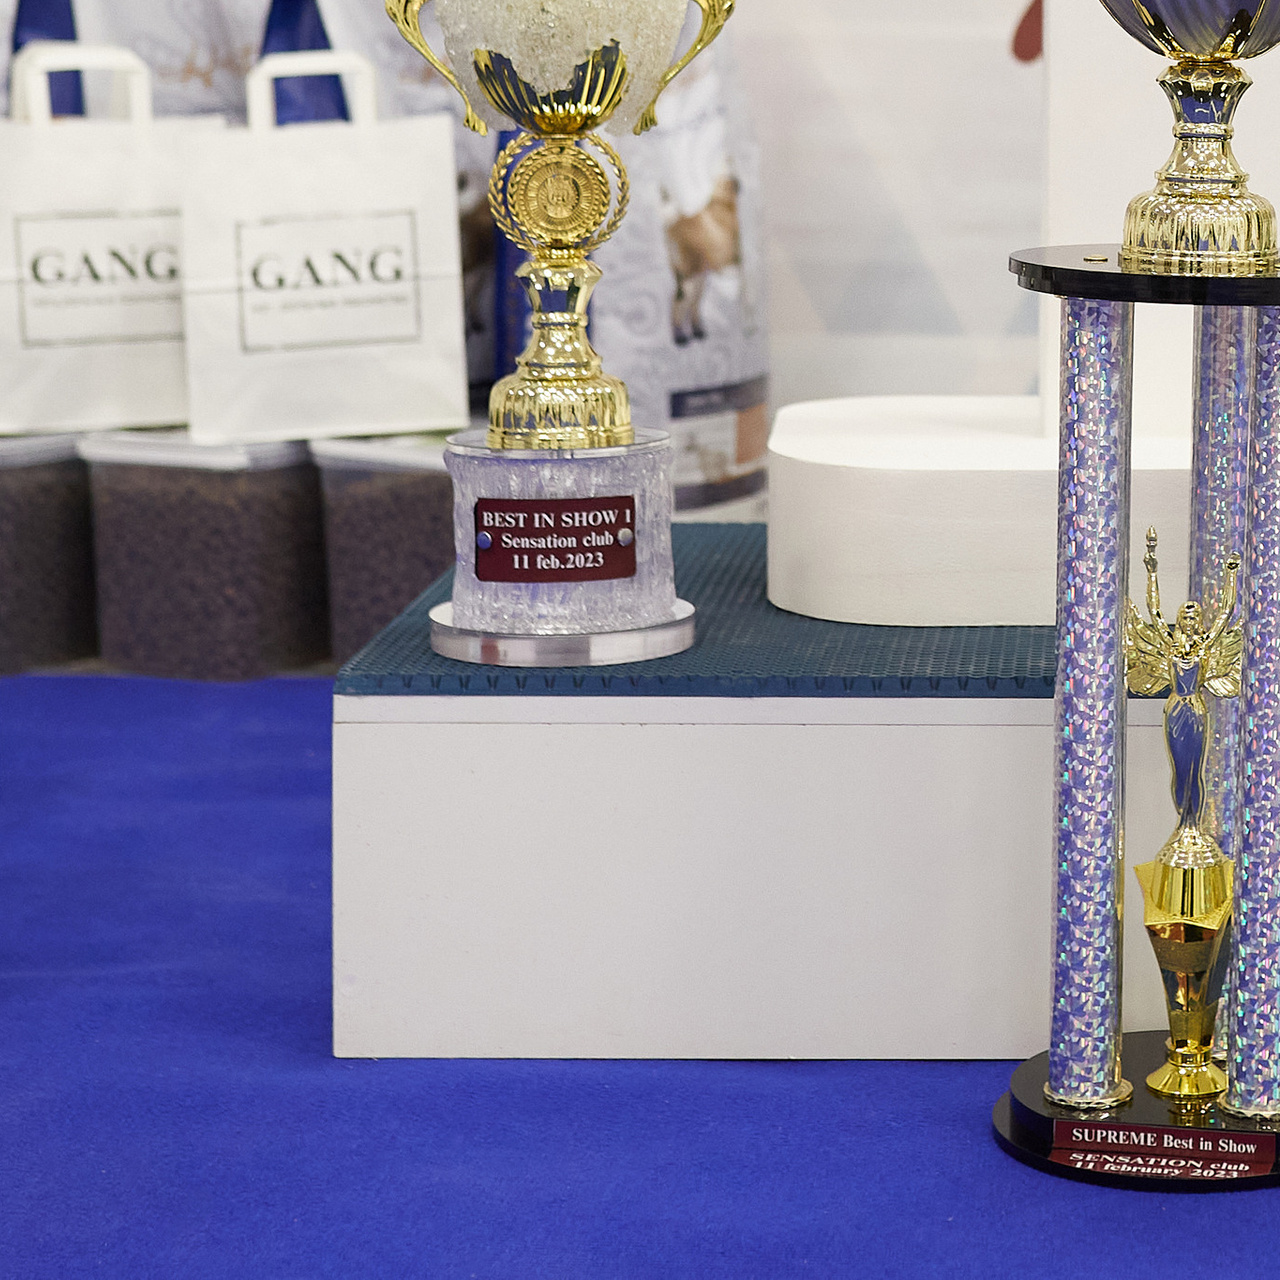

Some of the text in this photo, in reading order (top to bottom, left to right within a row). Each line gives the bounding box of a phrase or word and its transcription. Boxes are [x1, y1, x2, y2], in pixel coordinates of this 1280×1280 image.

[31, 244, 180, 286] GANG
[251, 244, 404, 292] GANG
[482, 508, 631, 528] BEST IN SHOW 1
[501, 530, 614, 549] Sensation club
[513, 552, 604, 570] 11 feb.2023
[1071, 1127, 1257, 1155] SUPREME Best in Show
[1069, 1152, 1250, 1173] SENSATION club
[1103, 1162, 1184, 1177] february
[1190, 1168, 1239, 1179] 2023
